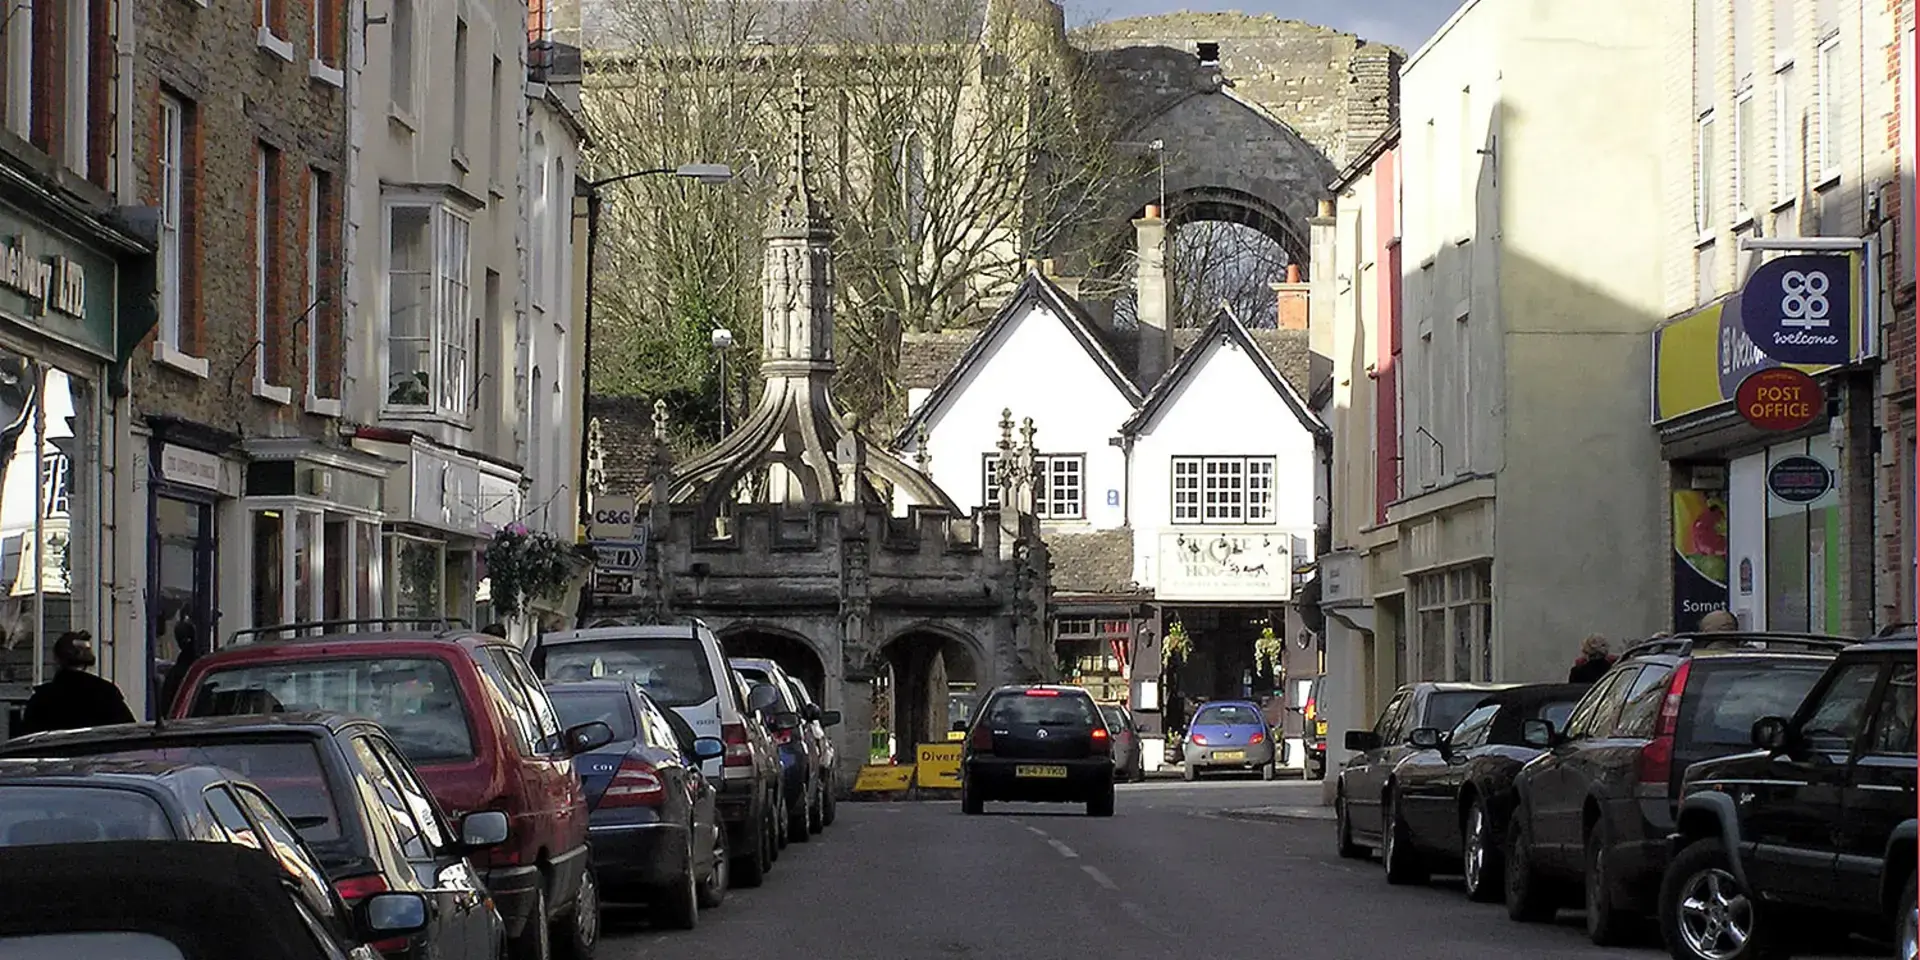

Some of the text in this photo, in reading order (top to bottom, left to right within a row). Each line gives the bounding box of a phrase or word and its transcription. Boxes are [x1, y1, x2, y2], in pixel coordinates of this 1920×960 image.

[1773, 331, 1839, 345] welcome
[1757, 386, 1801, 401] POST
[1750, 402, 1810, 418] OFFICE
[595, 510, 631, 525] C&G
